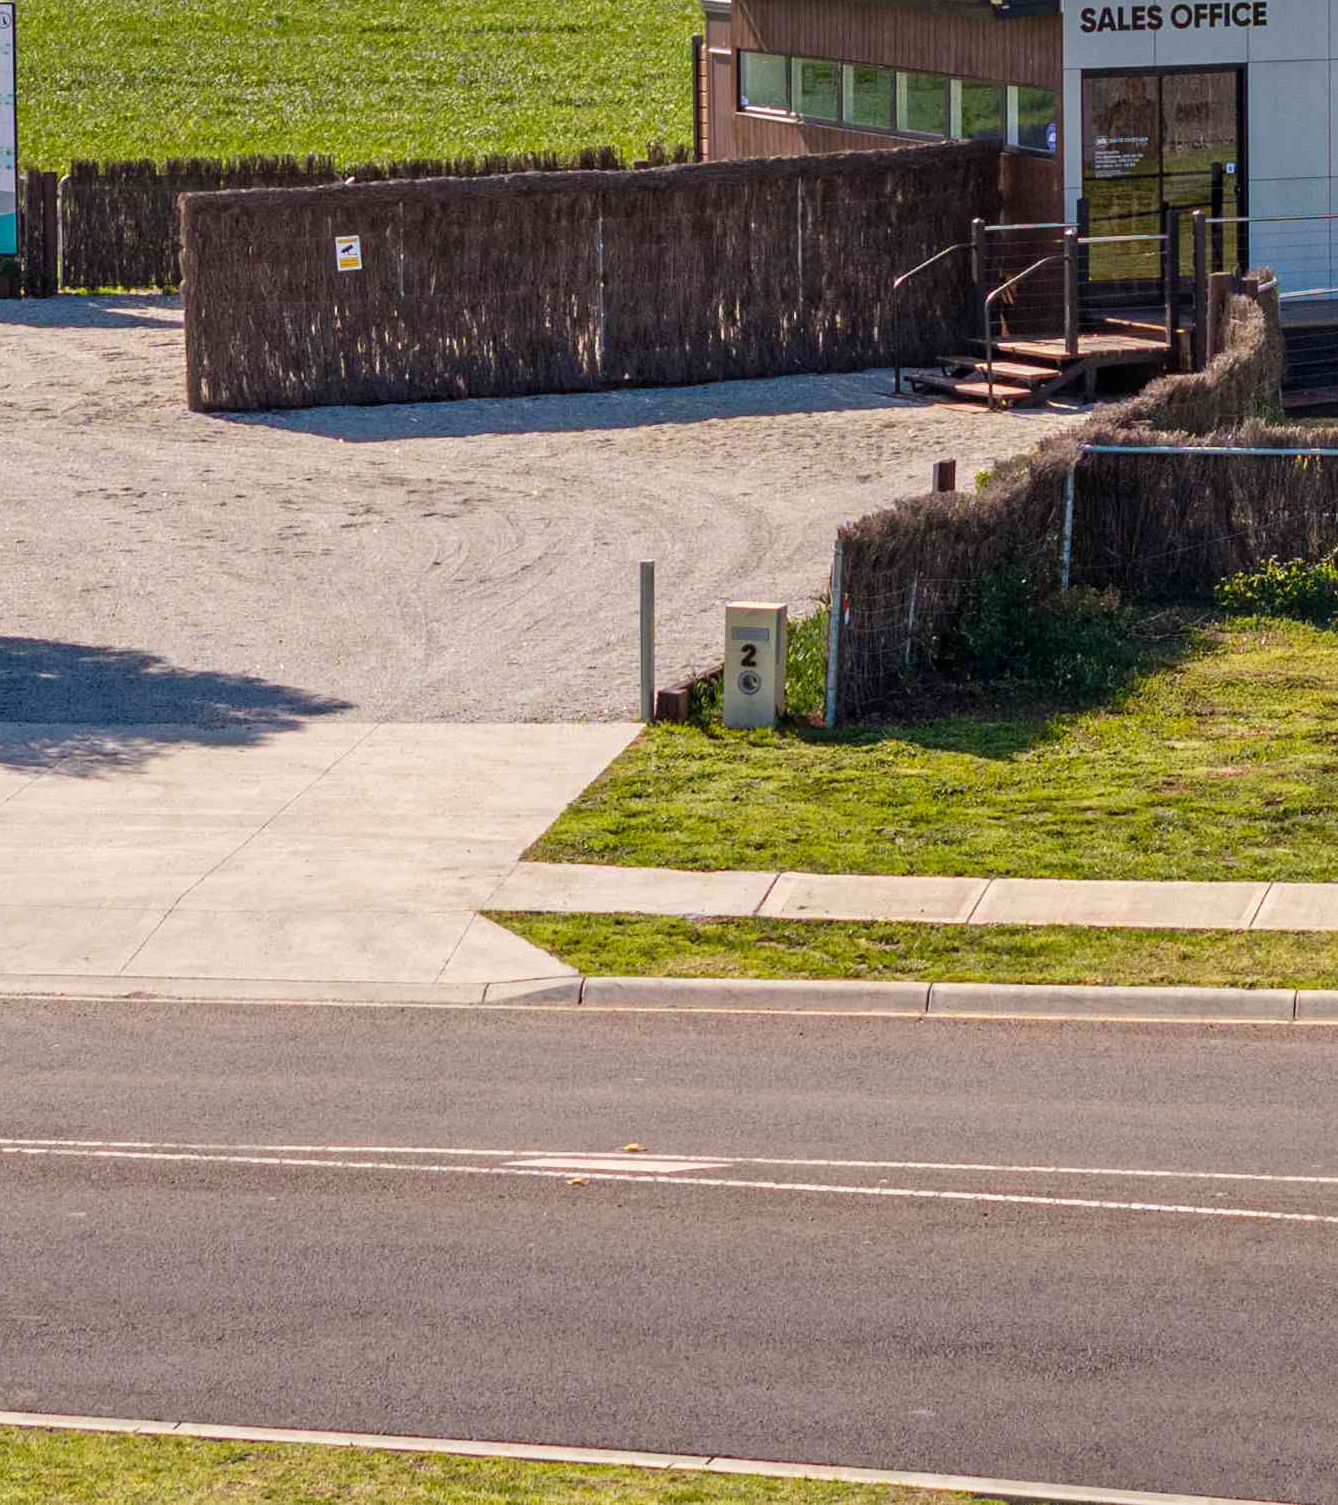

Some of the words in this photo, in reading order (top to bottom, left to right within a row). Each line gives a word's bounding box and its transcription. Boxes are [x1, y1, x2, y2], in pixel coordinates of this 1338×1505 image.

[1079, 5, 1164, 33] SALES
[1170, 1, 1268, 29] OFFICE
[740, 643, 758, 668] 2
